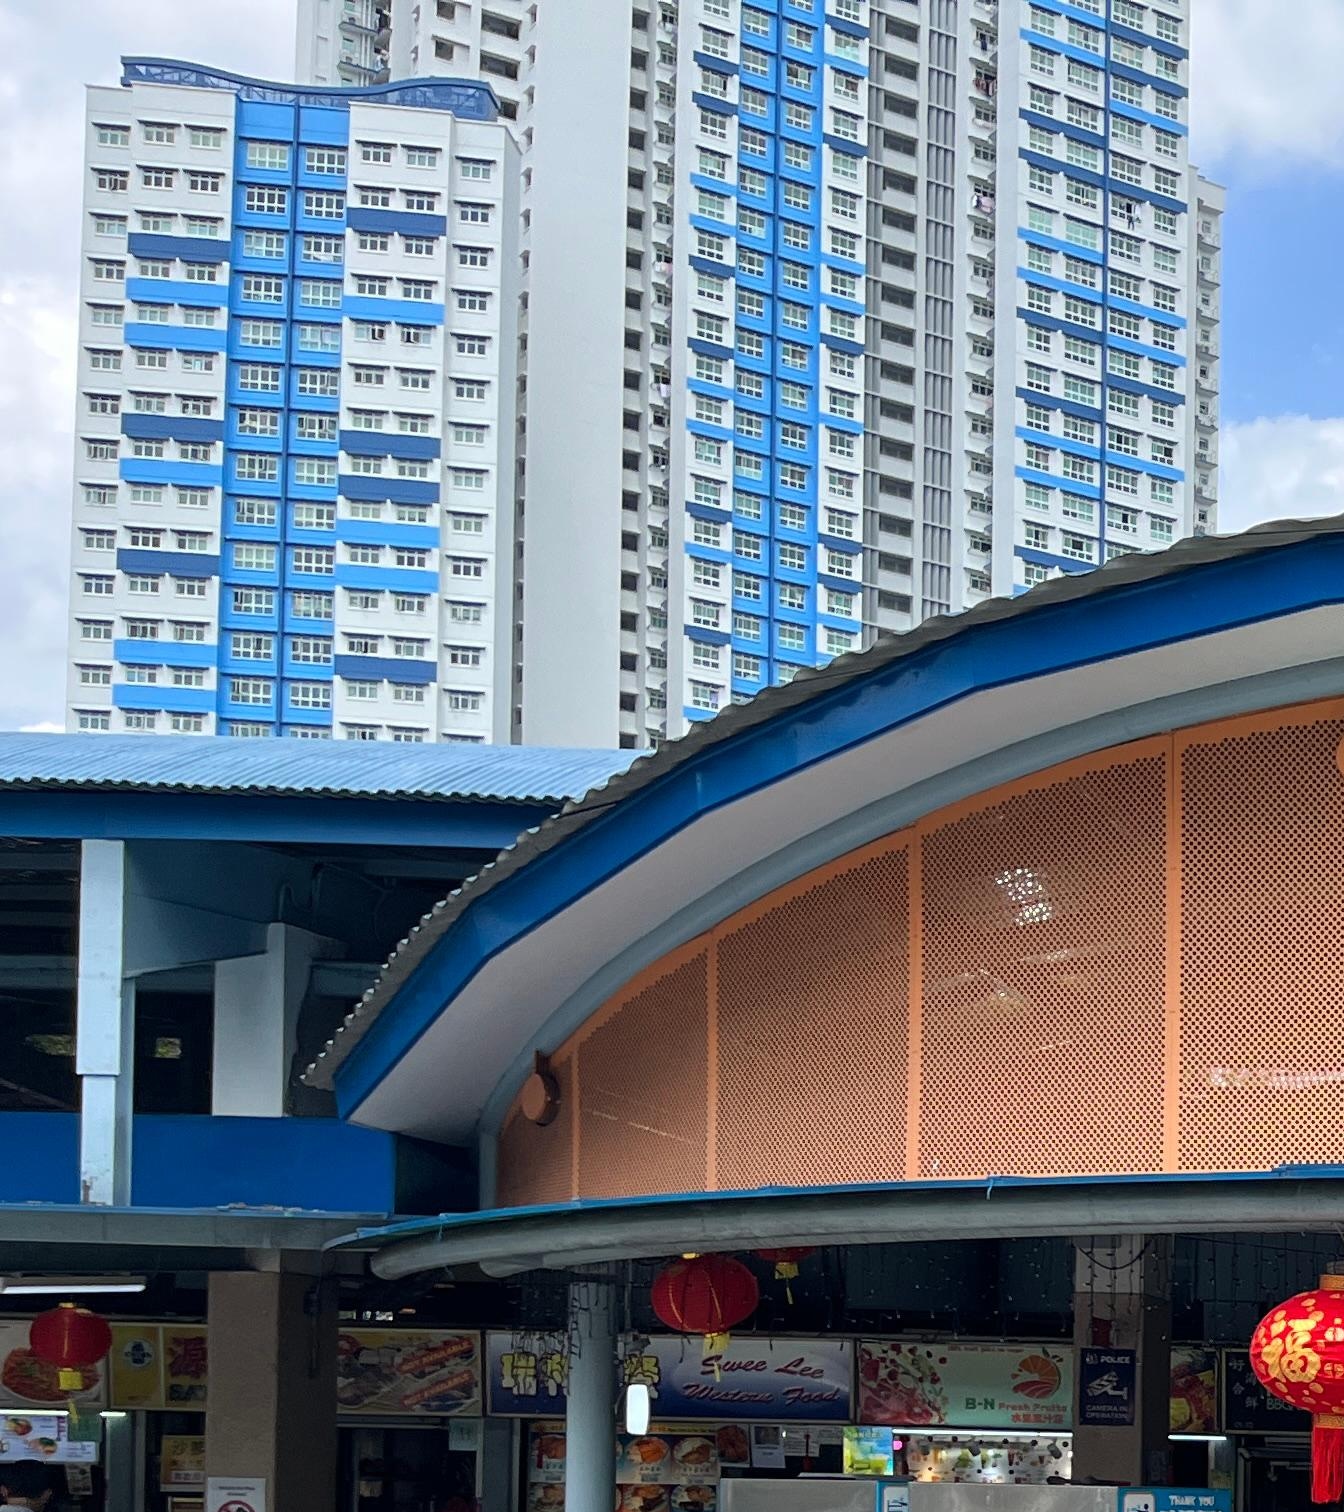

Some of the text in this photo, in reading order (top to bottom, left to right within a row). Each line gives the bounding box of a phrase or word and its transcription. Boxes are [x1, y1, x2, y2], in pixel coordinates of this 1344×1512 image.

[1100, 1356, 1131, 1365] POLICE
[700, 1354, 825, 1379] Swee Lee
[683, 1383, 841, 1407] Western Food
[965, 1398, 995, 1410] B-N
[1085, 1404, 1118, 1412] CAMERA
[1085, 1411, 1129, 1420] OPERATION
[1169, 1495, 1215, 1506] THANK YOU
